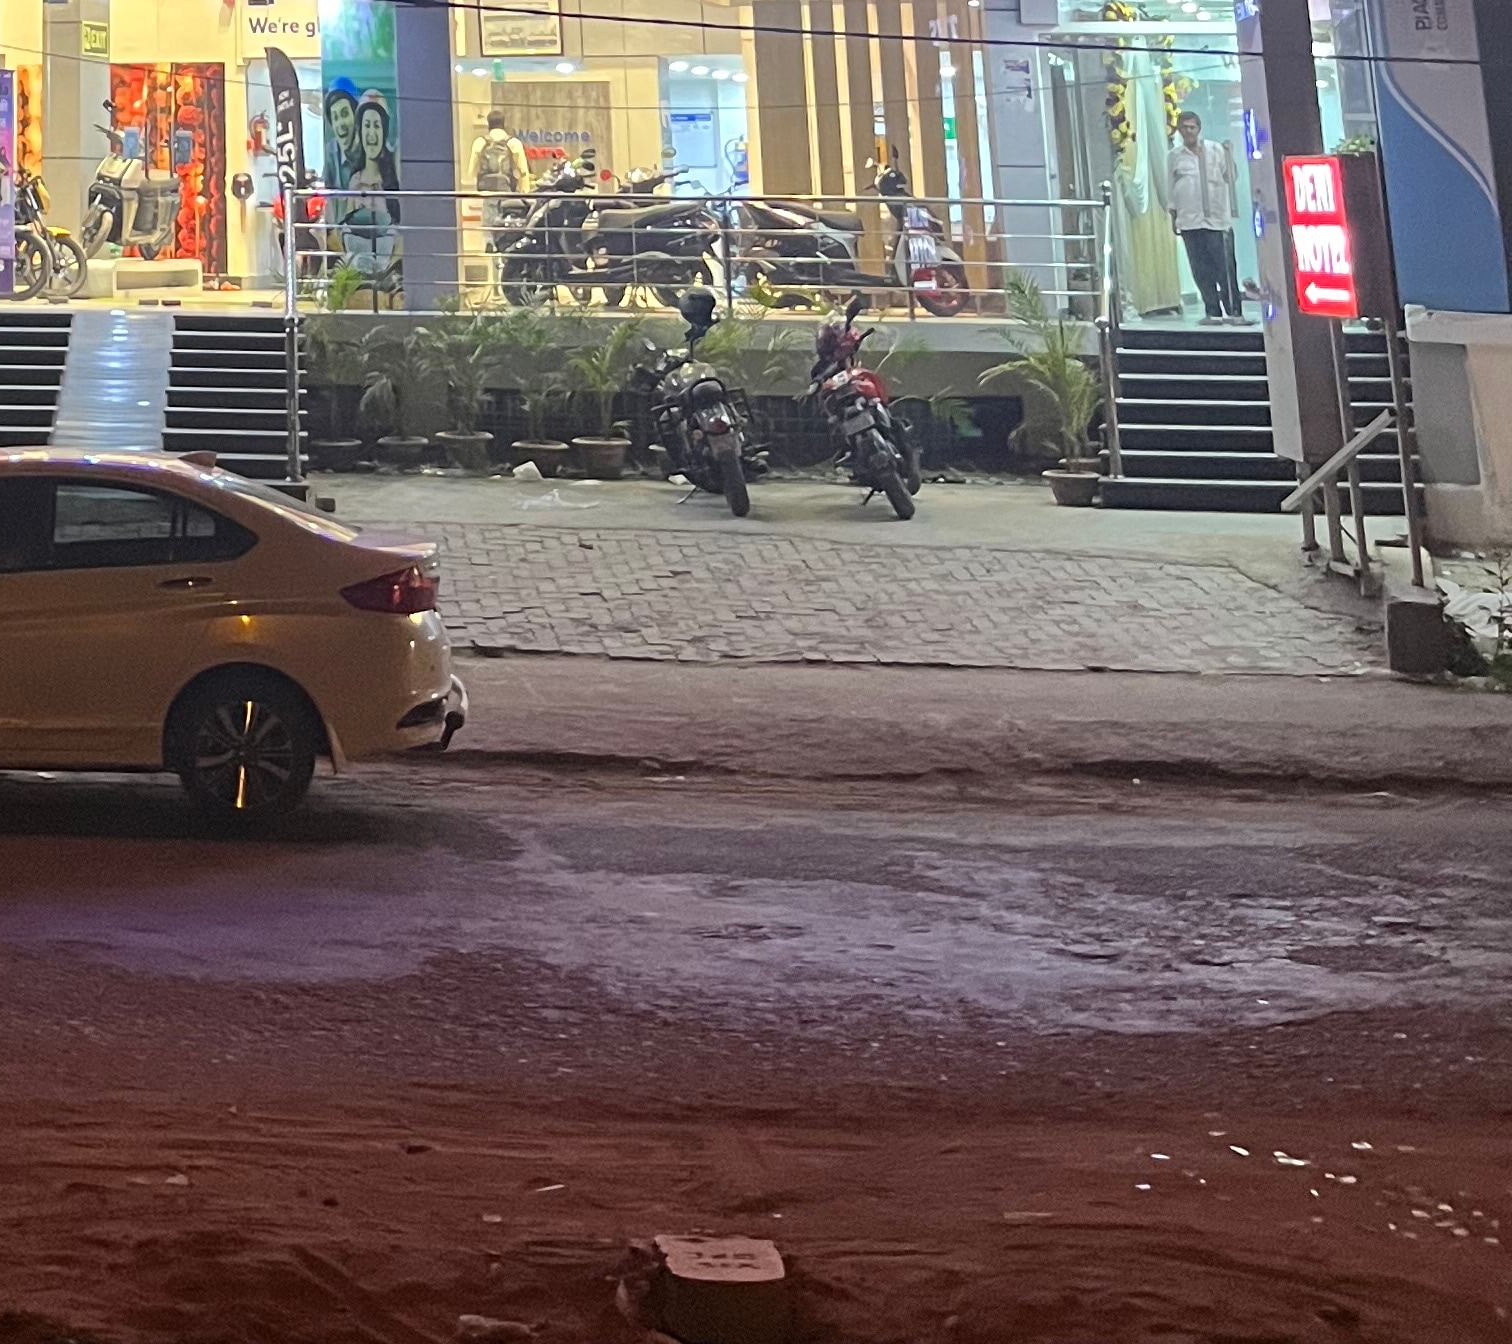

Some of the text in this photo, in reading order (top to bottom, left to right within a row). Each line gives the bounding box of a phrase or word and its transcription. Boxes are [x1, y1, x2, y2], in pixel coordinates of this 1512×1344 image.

[249, 16, 300, 34] We're
[513, 128, 591, 143] Welcome
[1292, 163, 1336, 213] DENI
[1292, 224, 1350, 275] HOTEL
